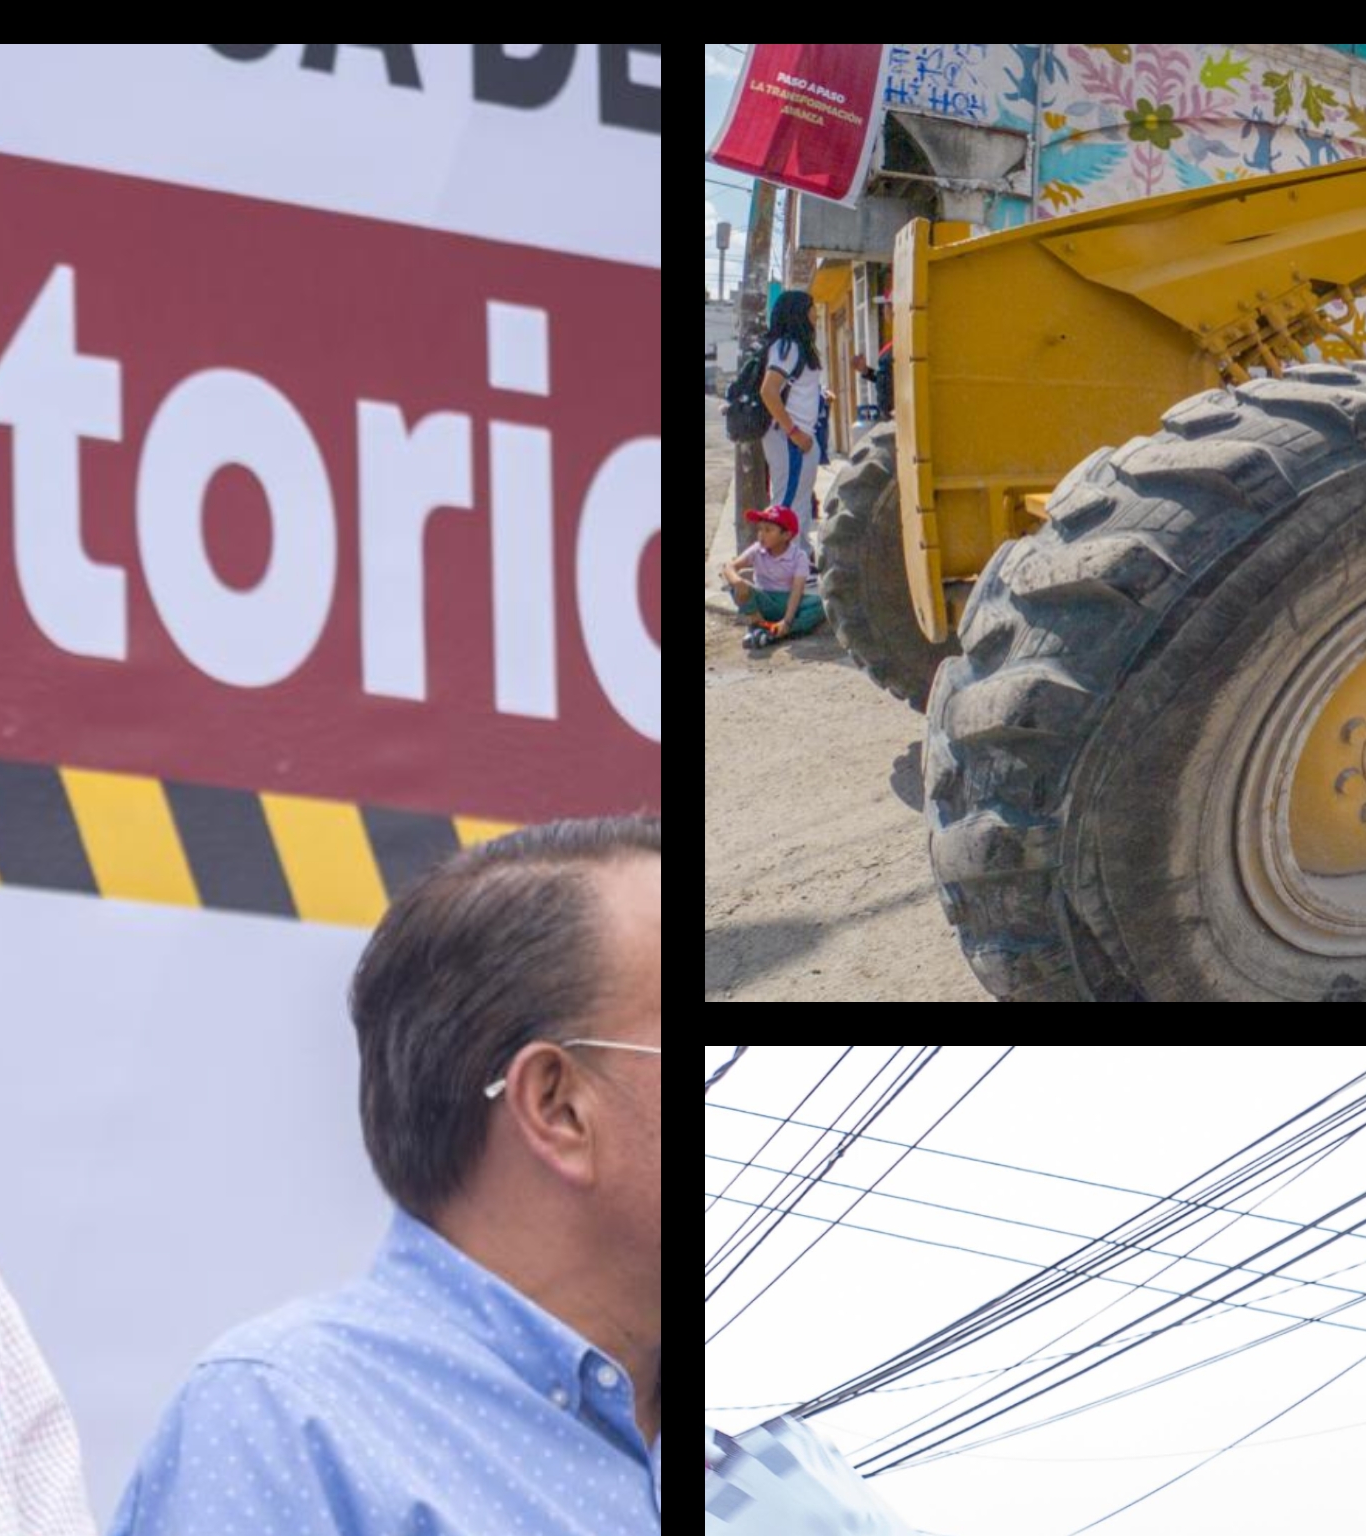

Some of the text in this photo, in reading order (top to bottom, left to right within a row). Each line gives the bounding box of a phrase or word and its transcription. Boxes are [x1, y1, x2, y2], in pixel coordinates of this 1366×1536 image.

[750, 80, 765, 92] LA
[777, 71, 846, 104] PASO A PASO
